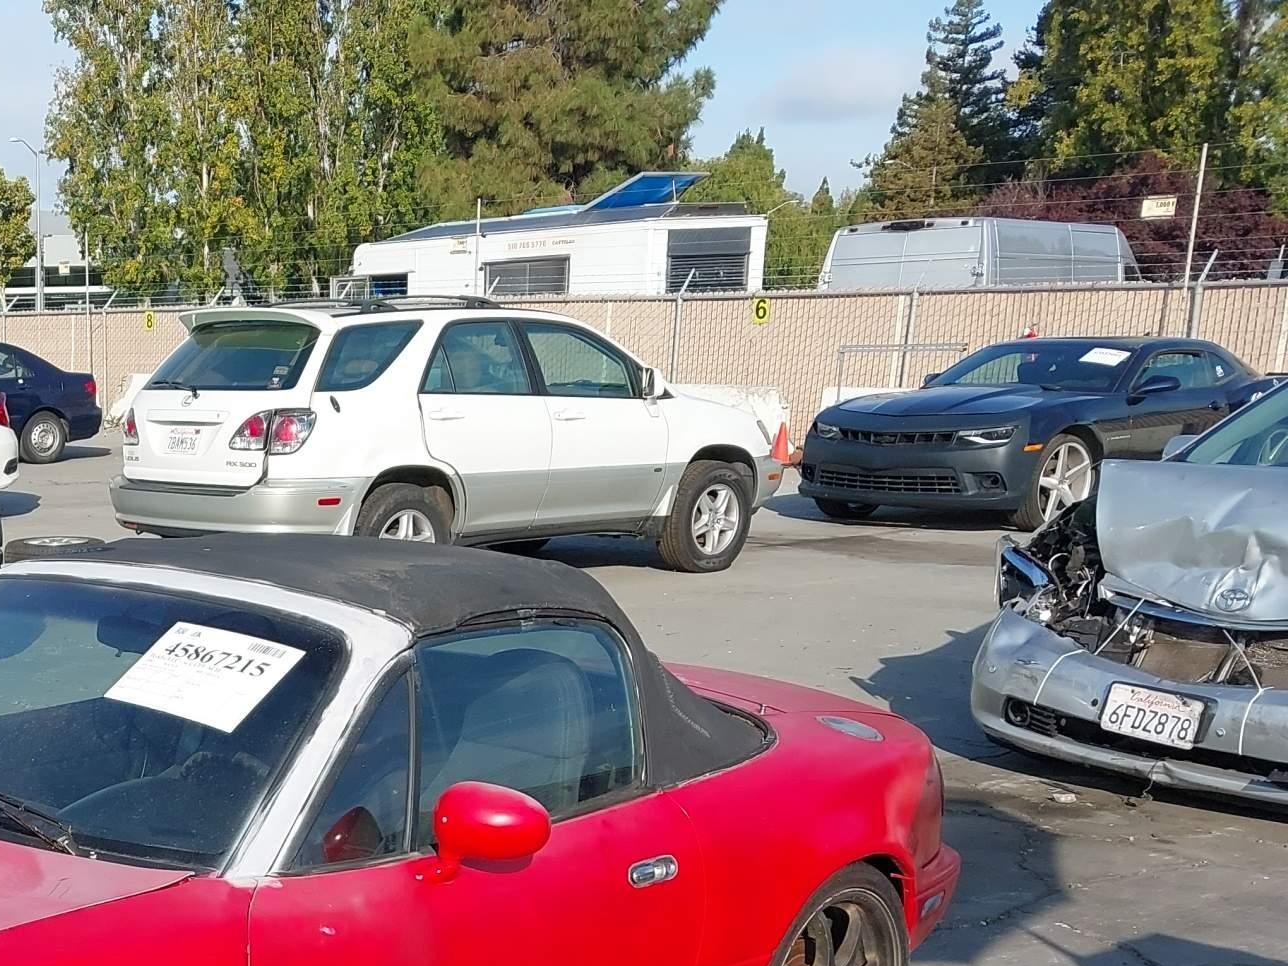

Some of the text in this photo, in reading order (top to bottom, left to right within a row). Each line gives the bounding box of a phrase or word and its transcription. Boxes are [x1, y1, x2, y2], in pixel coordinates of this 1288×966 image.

[756, 299, 767, 319] 6
[147, 314, 152, 328] 8
[165, 641, 271, 677] 45867215
[1130, 691, 1185, 712] California
[1108, 703, 1192, 741] 6FDZ878
